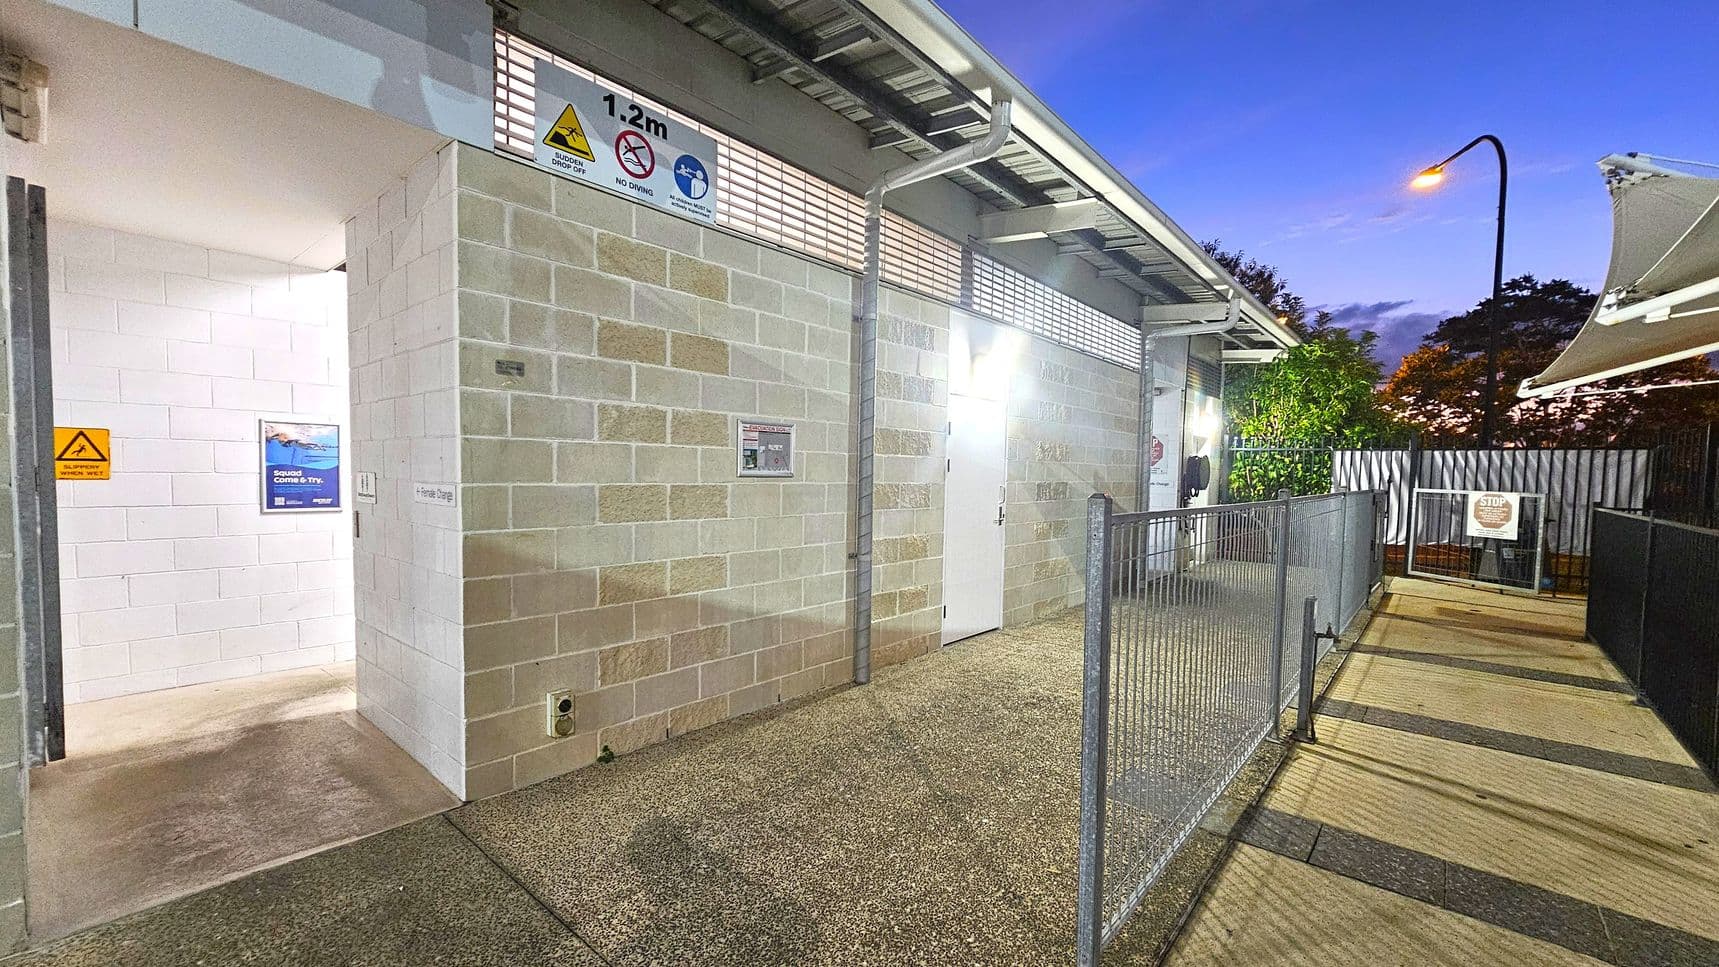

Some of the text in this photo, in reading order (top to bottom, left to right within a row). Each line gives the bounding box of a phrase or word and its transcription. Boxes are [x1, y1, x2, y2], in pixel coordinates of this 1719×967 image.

[602, 93, 668, 141] 1.2m
[552, 158, 587, 175] DROP OFF
[554, 151, 584, 168] SUDDEN
[615, 176, 654, 197] NO DIVING
[1479, 496, 1506, 507] STOP
